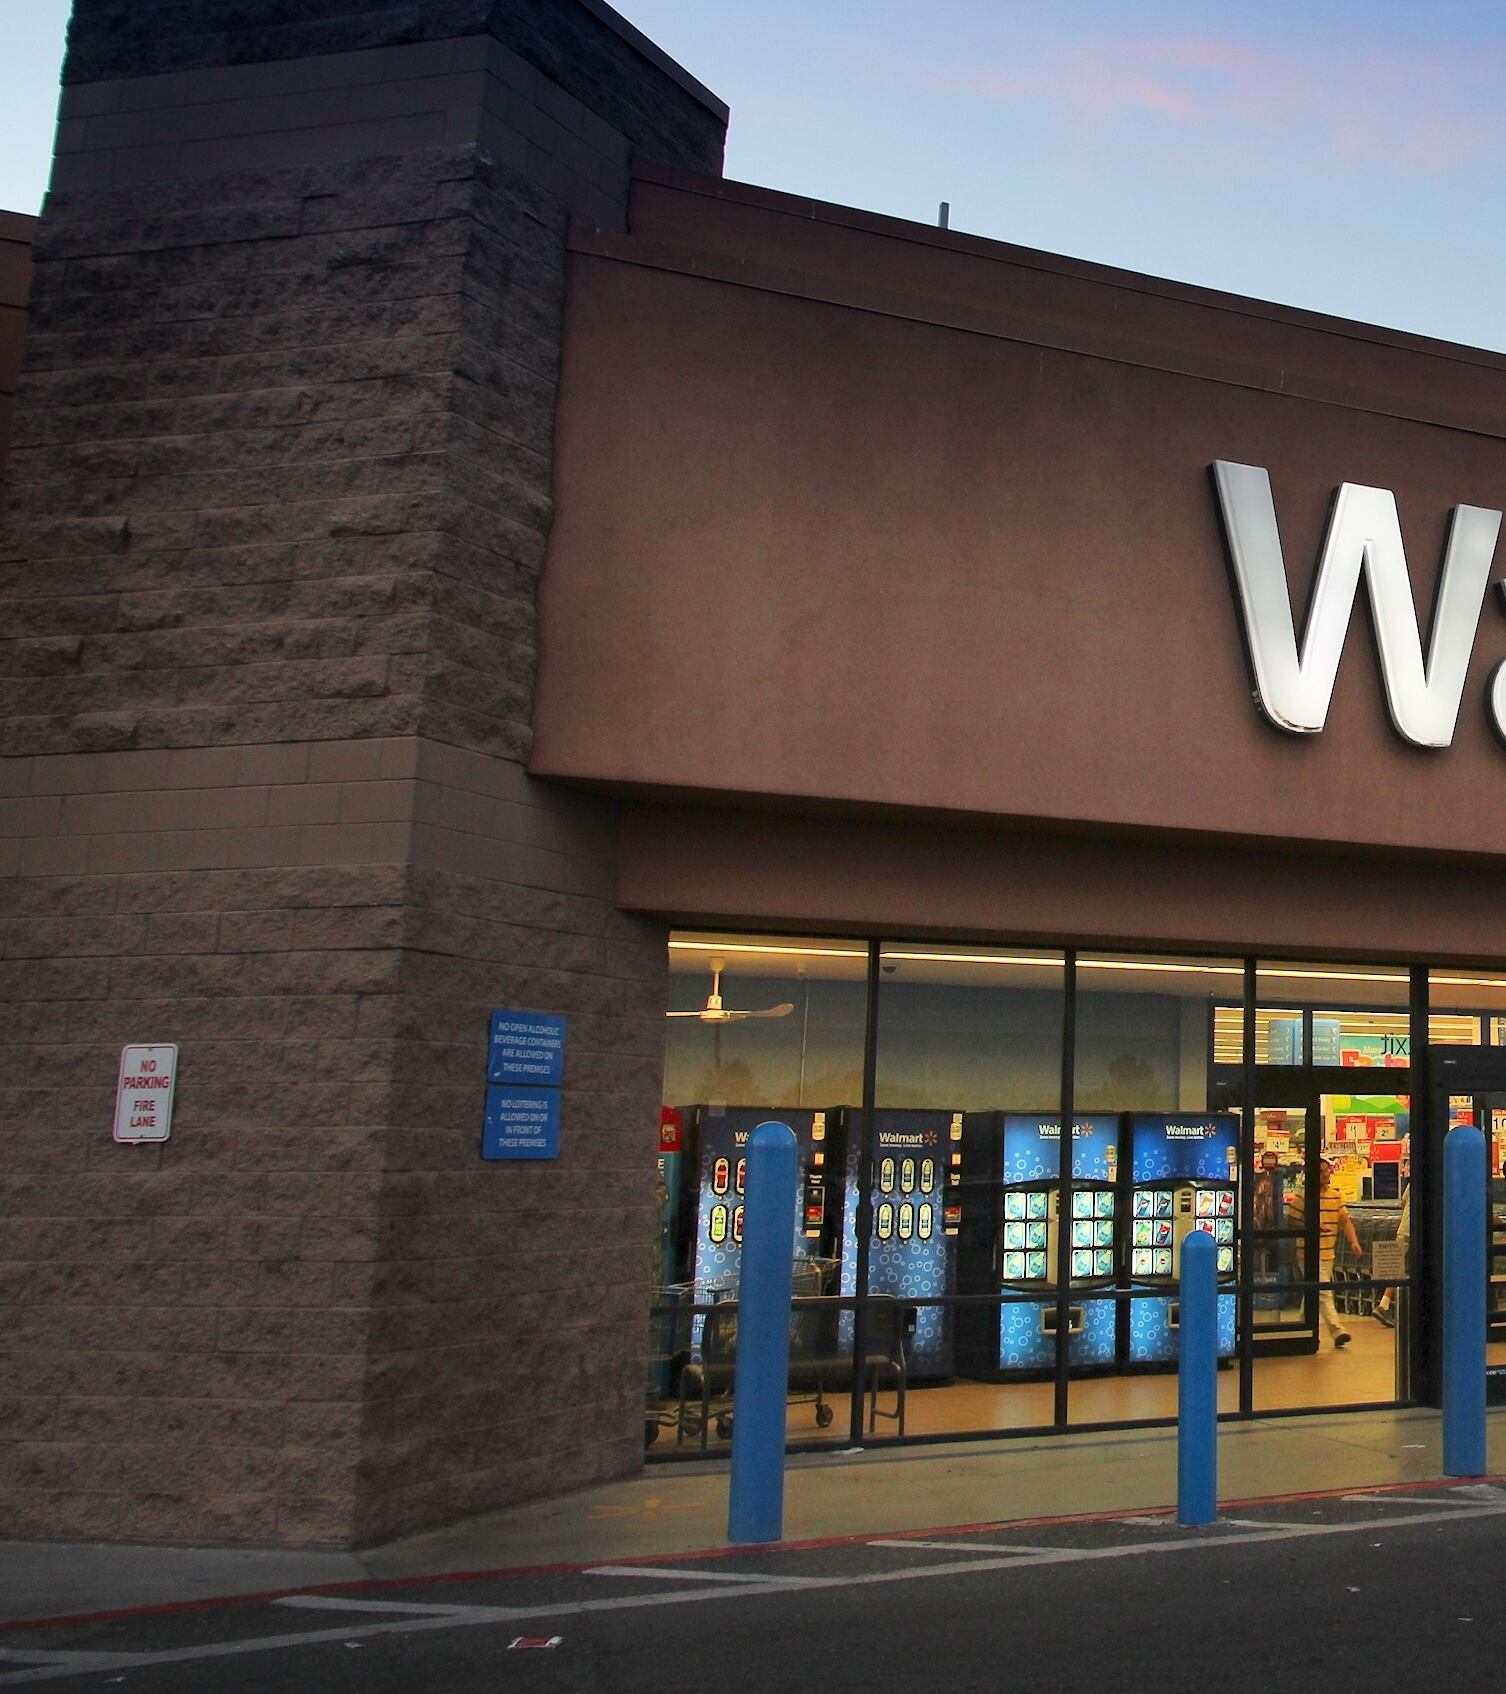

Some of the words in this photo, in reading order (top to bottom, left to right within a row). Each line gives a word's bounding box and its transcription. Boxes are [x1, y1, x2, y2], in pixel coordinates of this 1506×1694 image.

[498, 1022, 510, 1031] NO
[511, 1023, 528, 1032] OPEN
[140, 1060, 157, 1072] NO
[123, 1076, 169, 1089] PARKING
[133, 1100, 155, 1112] FIRE
[501, 1099, 511, 1108] NO
[130, 1116, 156, 1127] LANE
[1039, 1124, 1081, 1135] Walrt
[1165, 1125, 1205, 1136] Walmart
[879, 1132, 924, 1144] Walmart
